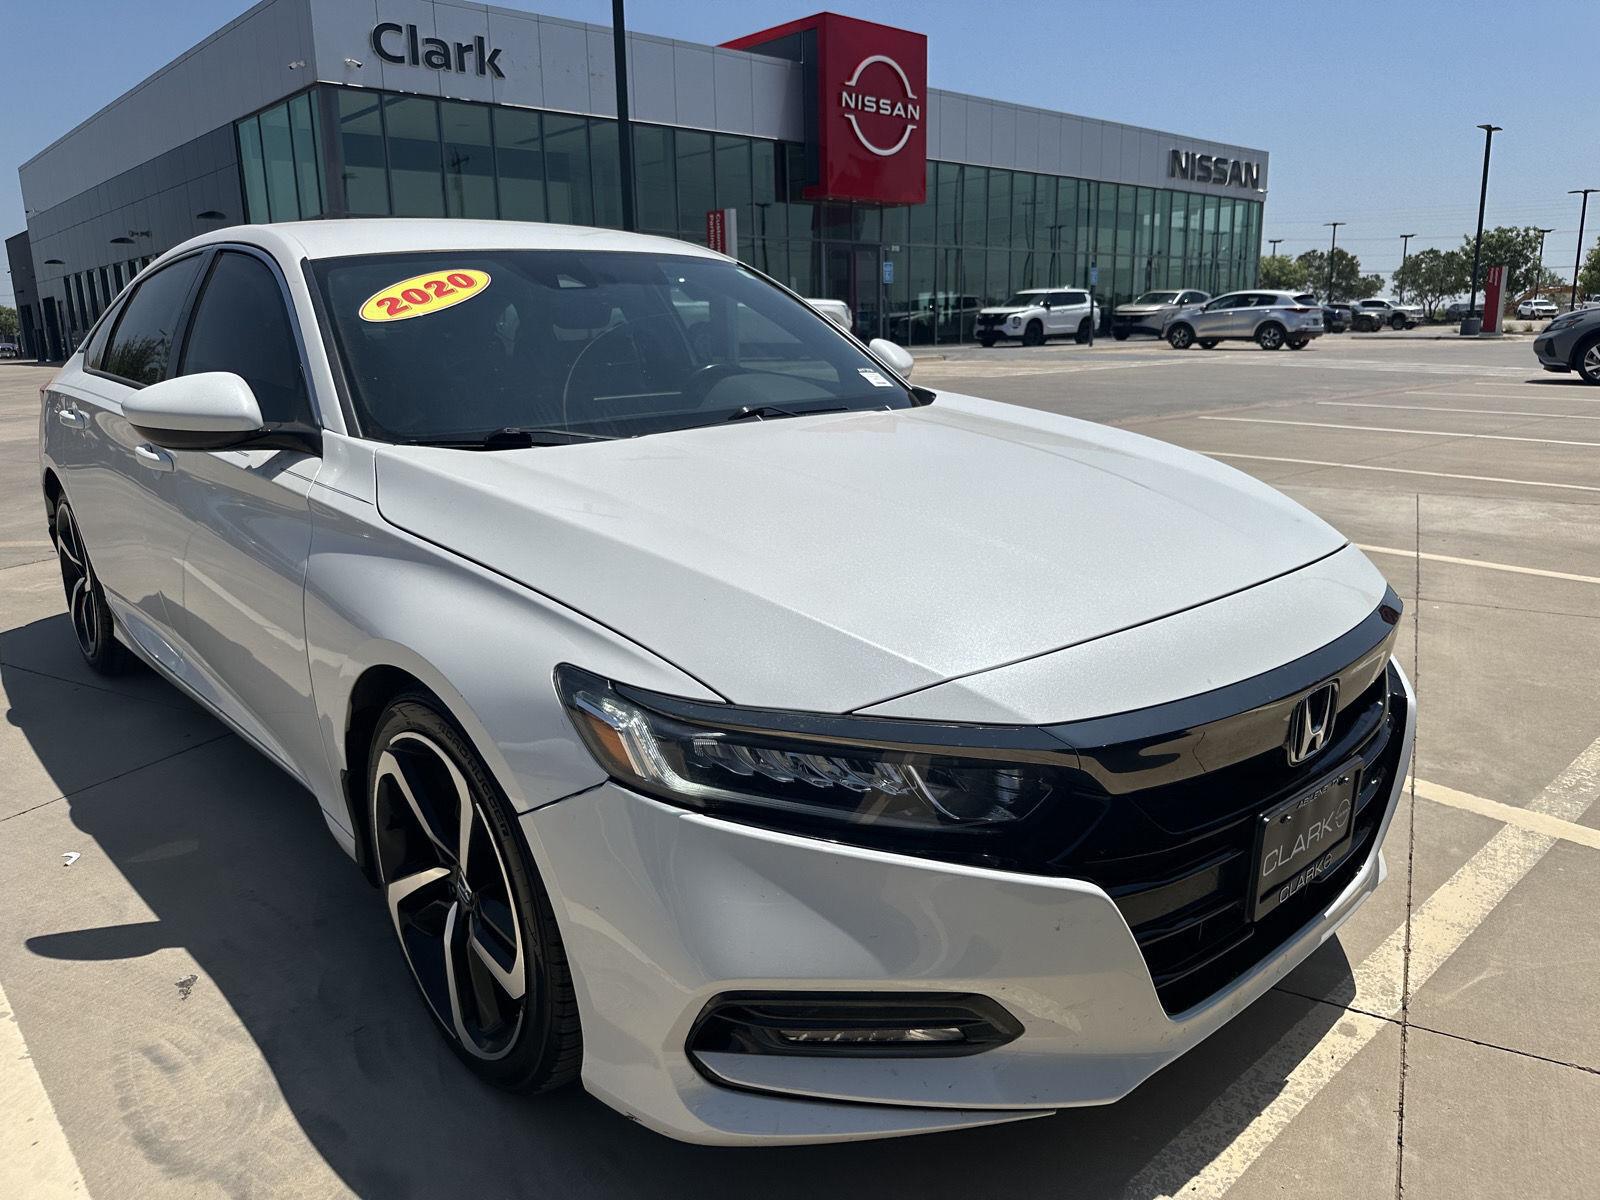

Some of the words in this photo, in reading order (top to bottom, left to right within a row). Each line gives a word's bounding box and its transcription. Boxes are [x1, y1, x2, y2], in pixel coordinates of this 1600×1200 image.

[370, 22, 506, 80] Clark
[841, 91, 920, 120] NISSAN
[1168, 148, 1260, 190] NISSAN
[376, 273, 478, 317] 2020
[1263, 811, 1334, 877] CLARK
[1279, 859, 1326, 903] CLARK
